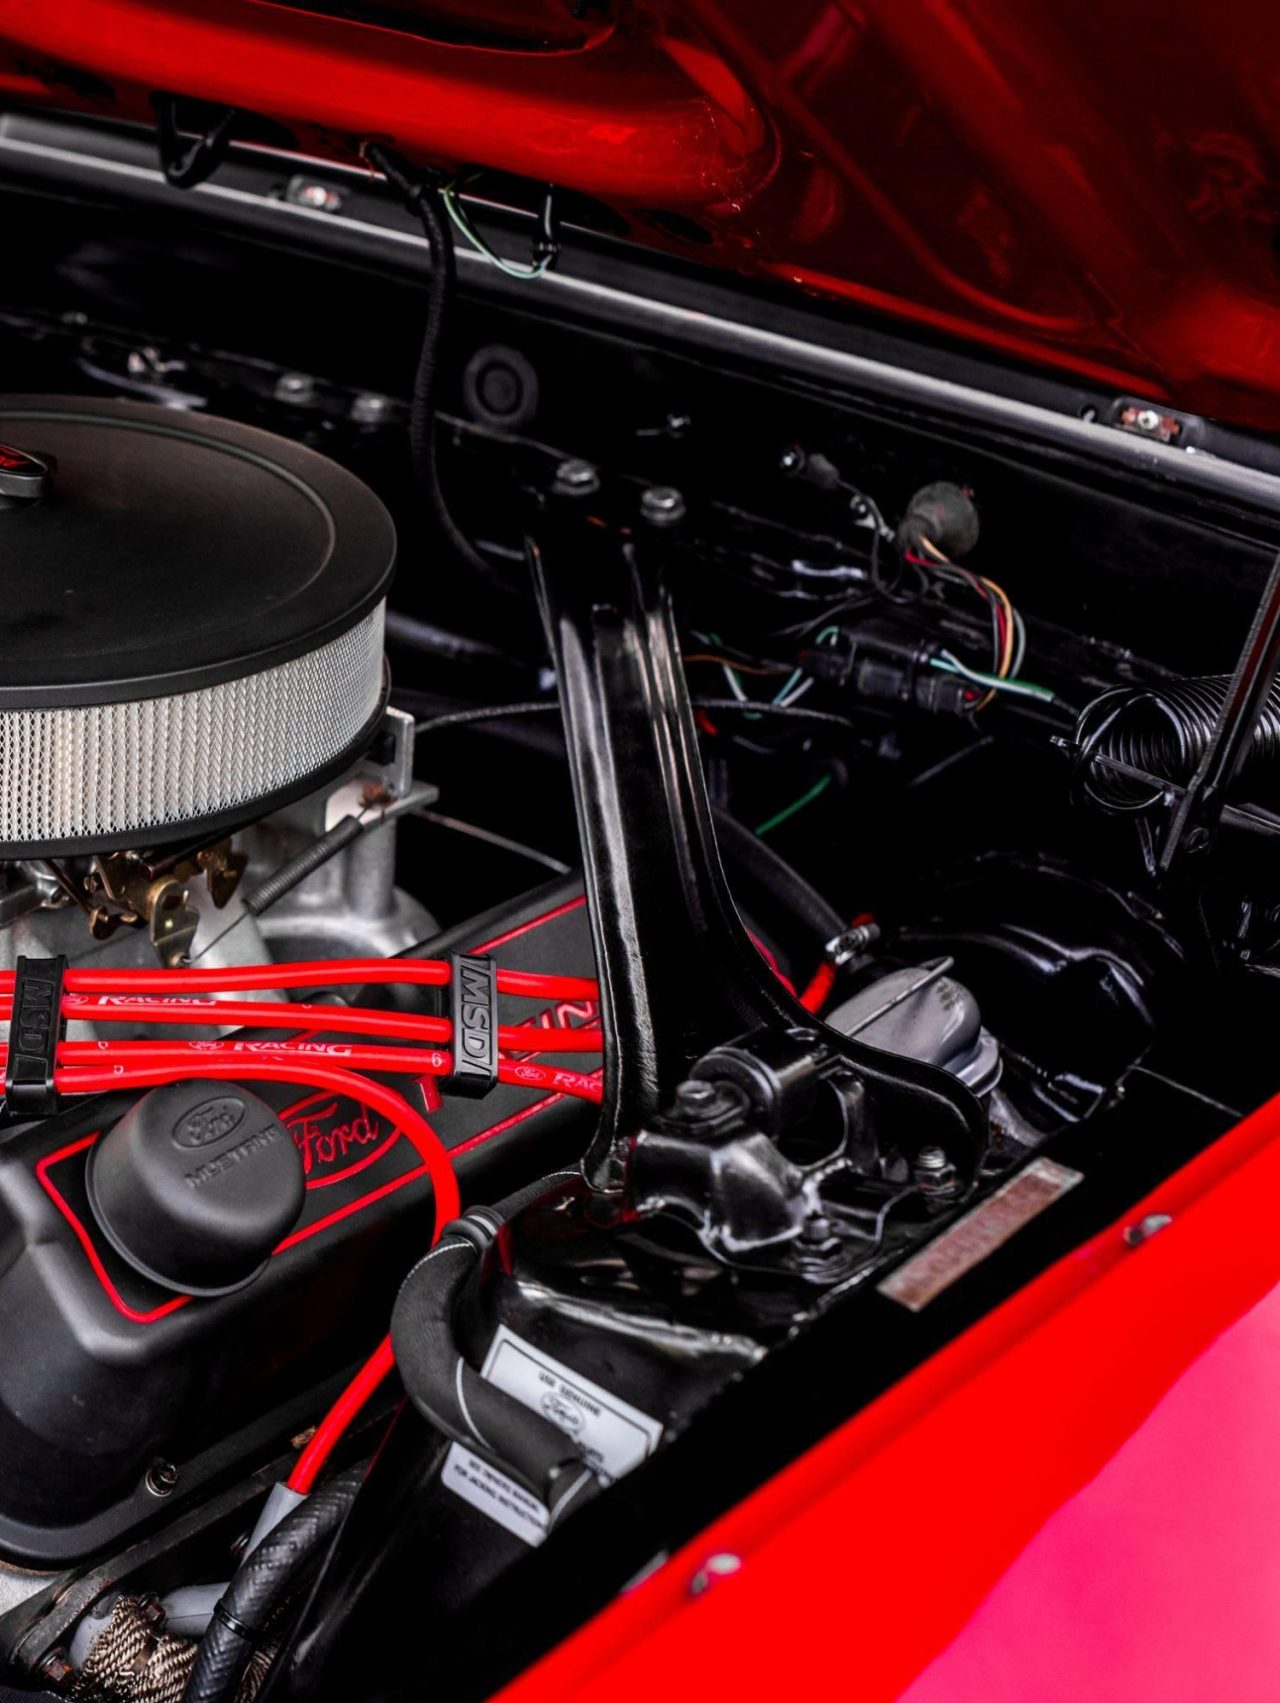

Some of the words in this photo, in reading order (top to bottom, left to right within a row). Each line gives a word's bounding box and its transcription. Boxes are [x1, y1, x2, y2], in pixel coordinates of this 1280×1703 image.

[98, 994, 218, 1007] RACING
[20, 979, 54, 1052] MSD
[461, 966, 492, 1068] MSD
[233, 1041, 353, 1057] RACING
[431, 1052, 442, 1068] 6
[518, 1066, 544, 1080] Ford
[553, 1072, 603, 1092] RAC
[287, 1101, 379, 1175] Ford
